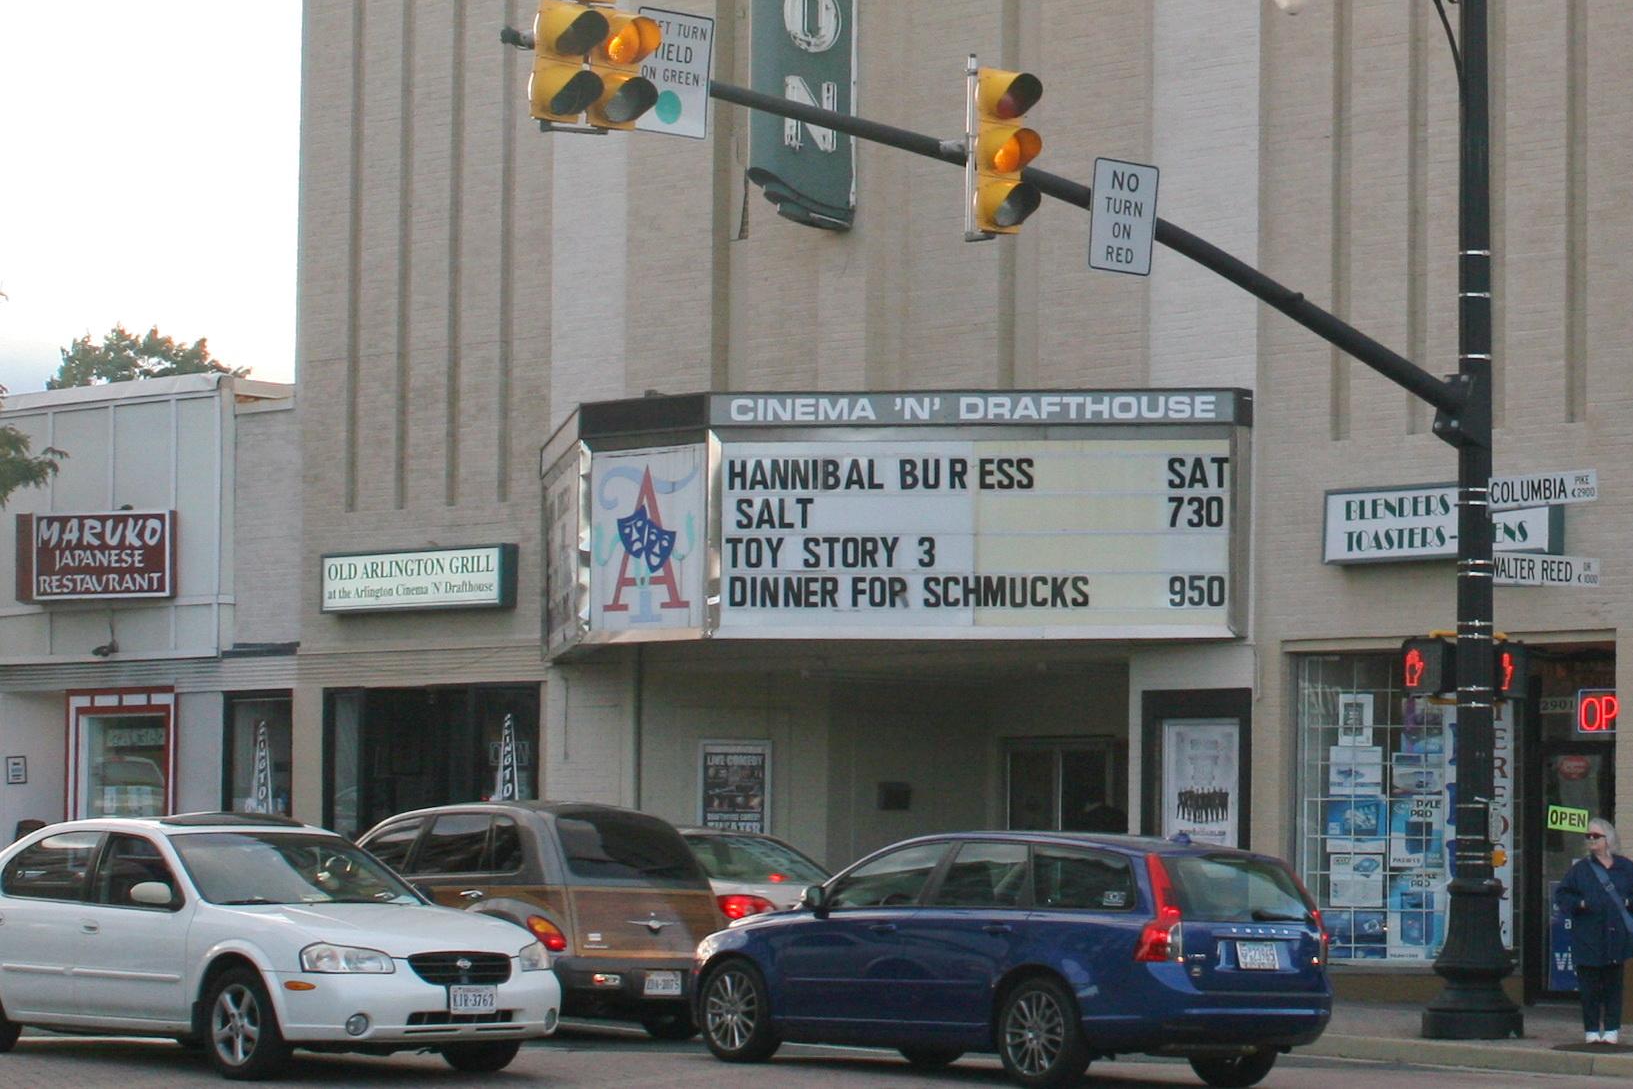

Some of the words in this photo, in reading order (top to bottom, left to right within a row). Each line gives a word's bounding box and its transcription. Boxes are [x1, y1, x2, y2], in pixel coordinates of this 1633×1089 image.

[678, 23, 708, 41] TURN
[641, 65, 657, 80] ON
[662, 68, 700, 87] GREEN
[1111, 170, 1139, 192] NO
[1105, 196, 1143, 218] TURN
[1112, 222, 1131, 240] ON
[1105, 245, 1134, 264] RED
[730, 397, 876, 421] CINEMA
[894, 397, 941, 420] 'N'
[959, 395, 1216, 421] DRAFTHOUSE
[728, 458, 884, 491] HANNIBAL
[1167, 457, 1229, 489] SAT
[1490, 477, 1567, 504] COLUMBIA
[1575, 474, 1590, 486] PIKE
[735, 498, 814, 529] SALT
[1168, 496, 1224, 528] 730
[37, 517, 163, 548] MARUKO
[54, 549, 145, 572] JAPANESE
[726, 537, 785, 569] TOY
[803, 537, 899, 569] STORY
[917, 536, 936, 568] 3
[328, 561, 358, 581] OLD
[360, 557, 446, 580] ARLINGTON
[449, 554, 494, 574] GRILL
[1541, 560, 1573, 583] REED
[38, 572, 163, 593] RESTAURANT
[328, 588, 337, 600] at
[339, 587, 351, 599] the
[353, 585, 394, 600] Arlington
[396, 583, 429, 596] Cinema
[444, 579, 494, 594] Drafthouse
[729, 576, 839, 608] DINNER
[851, 576, 910, 608] FOR
[923, 575, 1089, 608] SCHMUCKS
[1168, 574, 1226, 607] 950
[1541, 699, 1575, 710] 2901
[1580, 695, 1619, 731] OP
[1549, 808, 1587, 828] OPEN
